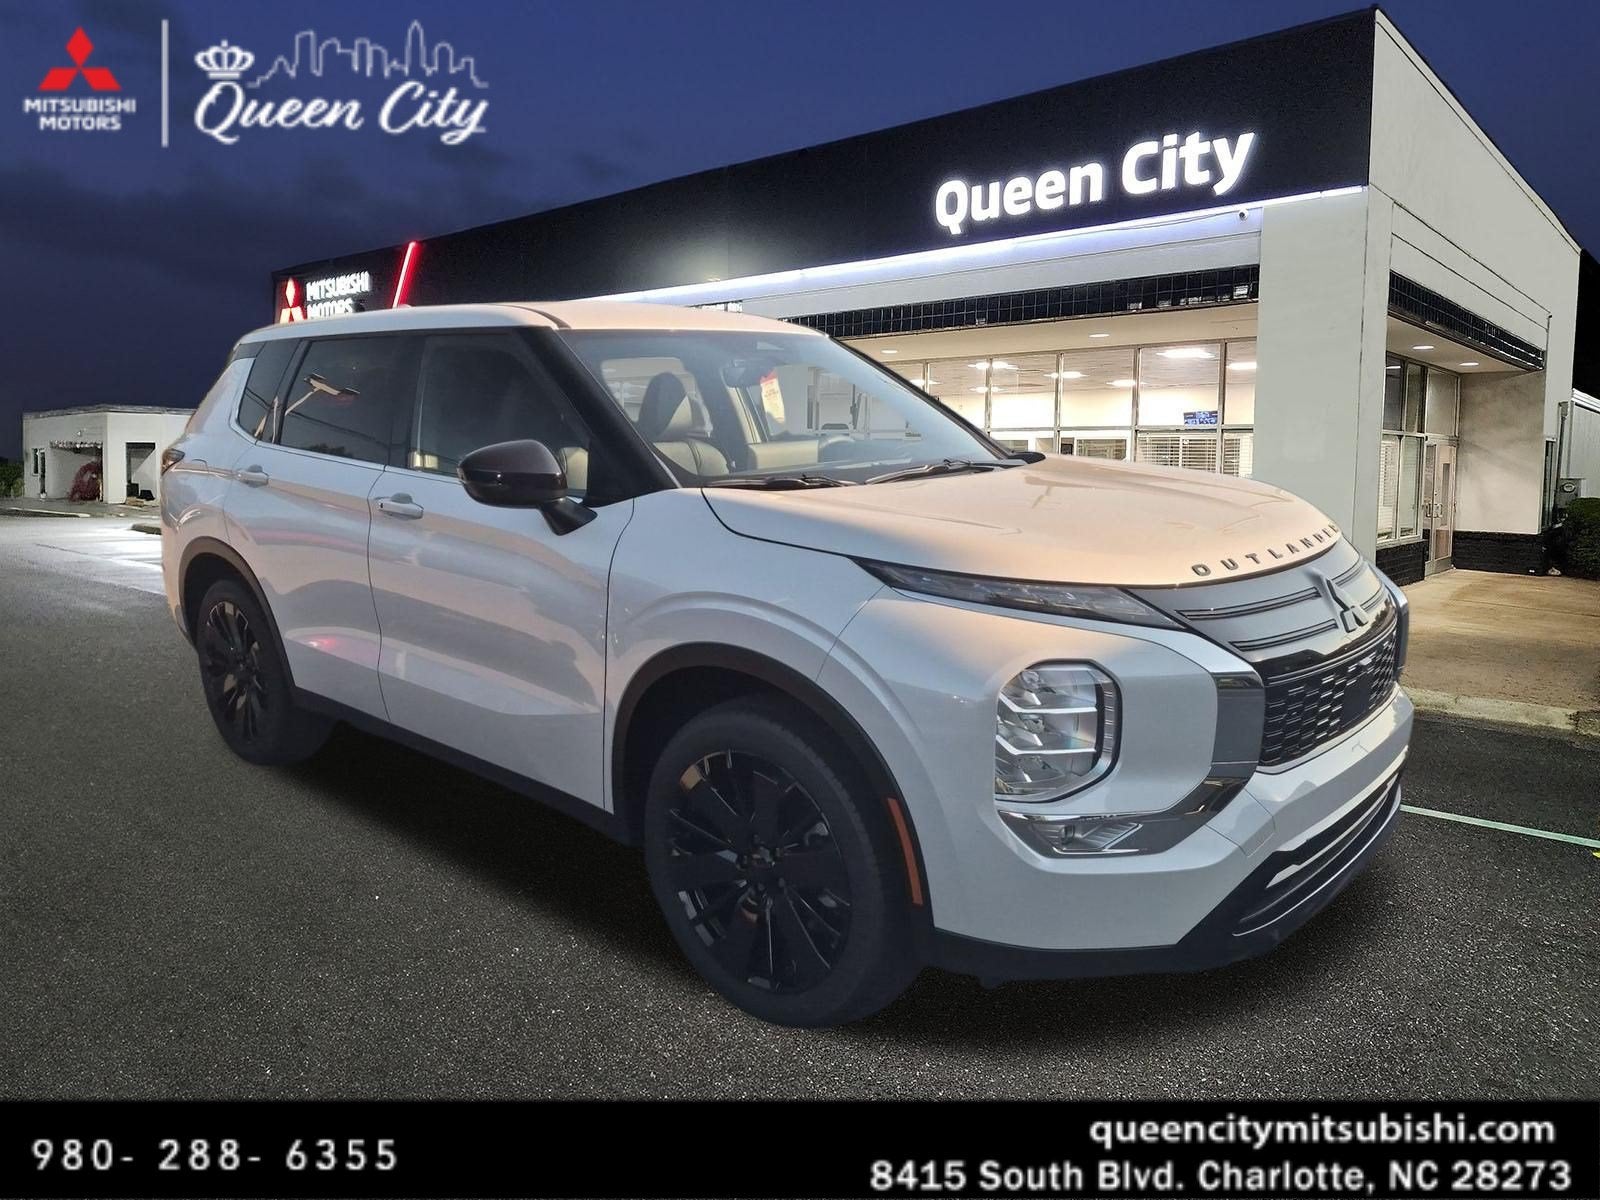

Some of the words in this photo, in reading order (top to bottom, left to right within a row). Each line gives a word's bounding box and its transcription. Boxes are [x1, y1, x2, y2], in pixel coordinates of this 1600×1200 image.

[935, 161, 1104, 234] Queen
[1121, 131, 1255, 196] City
[306, 271, 370, 301] MITSUBISHI
